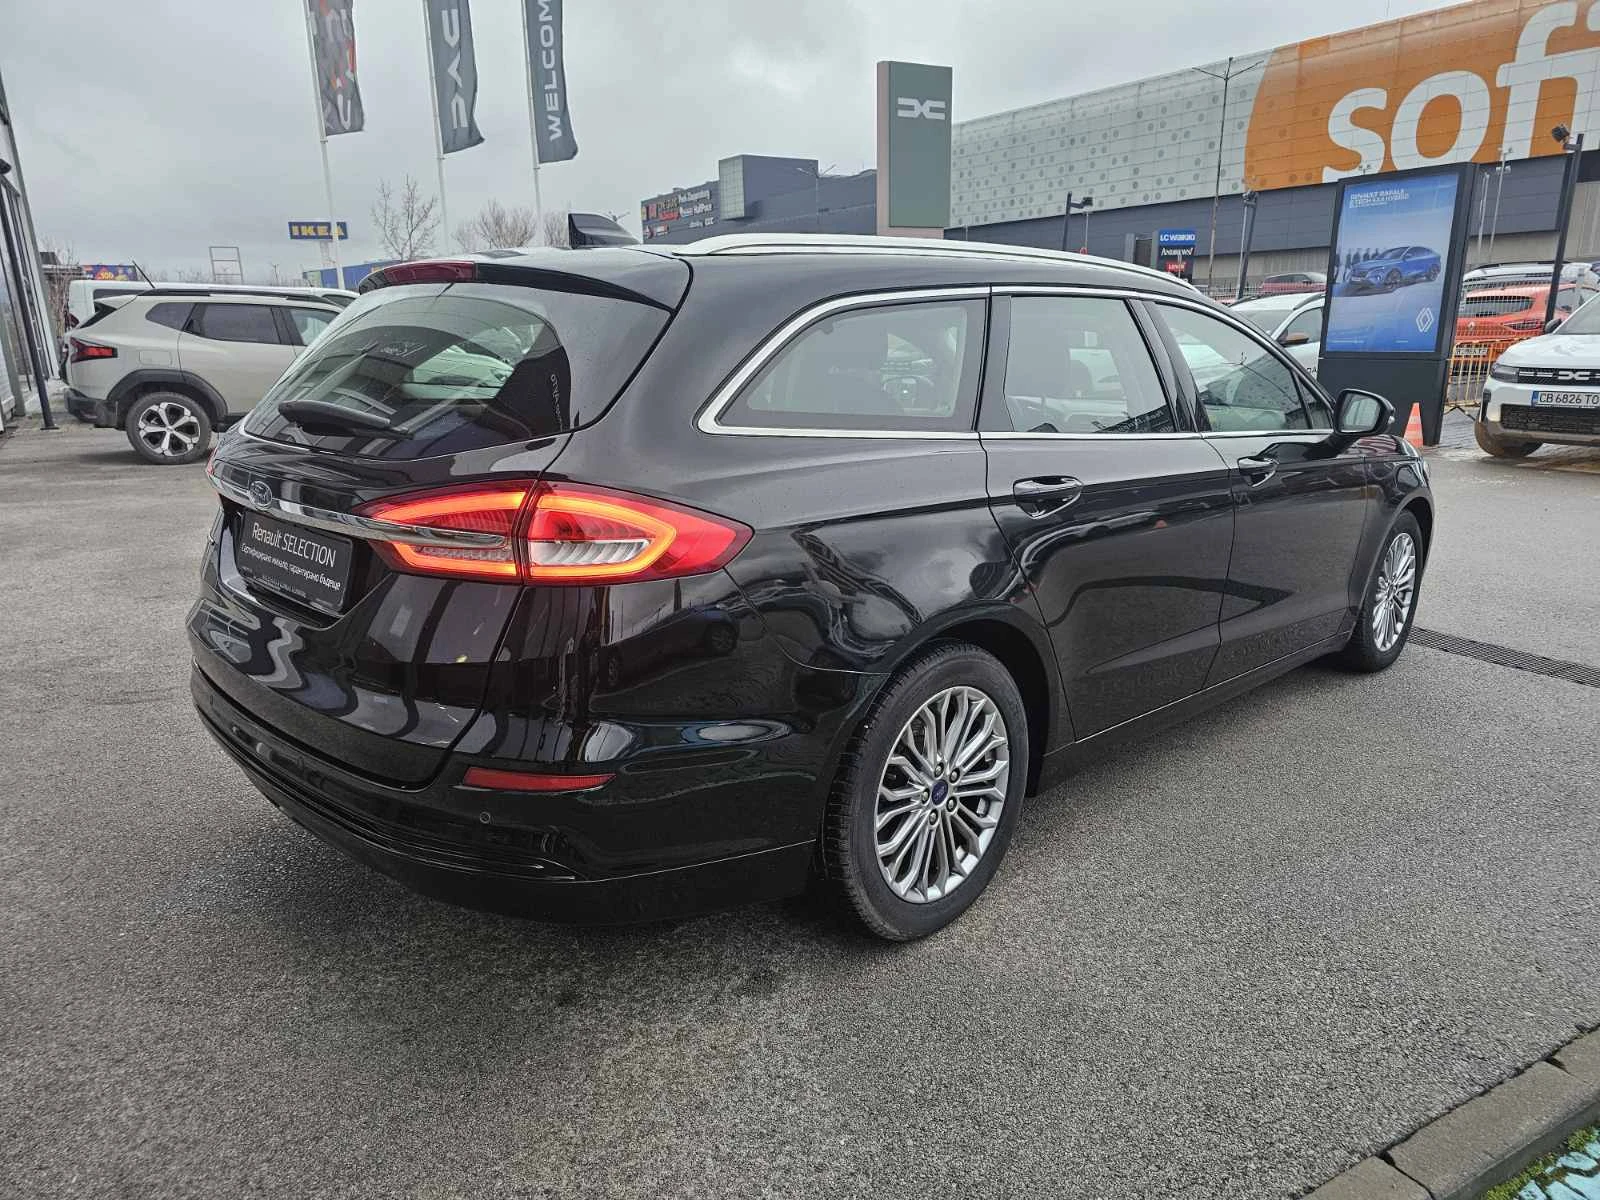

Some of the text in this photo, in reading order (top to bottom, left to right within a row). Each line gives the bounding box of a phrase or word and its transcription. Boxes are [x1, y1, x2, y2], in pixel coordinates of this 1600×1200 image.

[291, 225, 345, 236] IKEA
[1539, 393, 1554, 404] CB
[1555, 394, 1582, 404] 6826
[252, 522, 336, 568] Renault SELECTION
[319, 573, 341, 591] бъдеще
